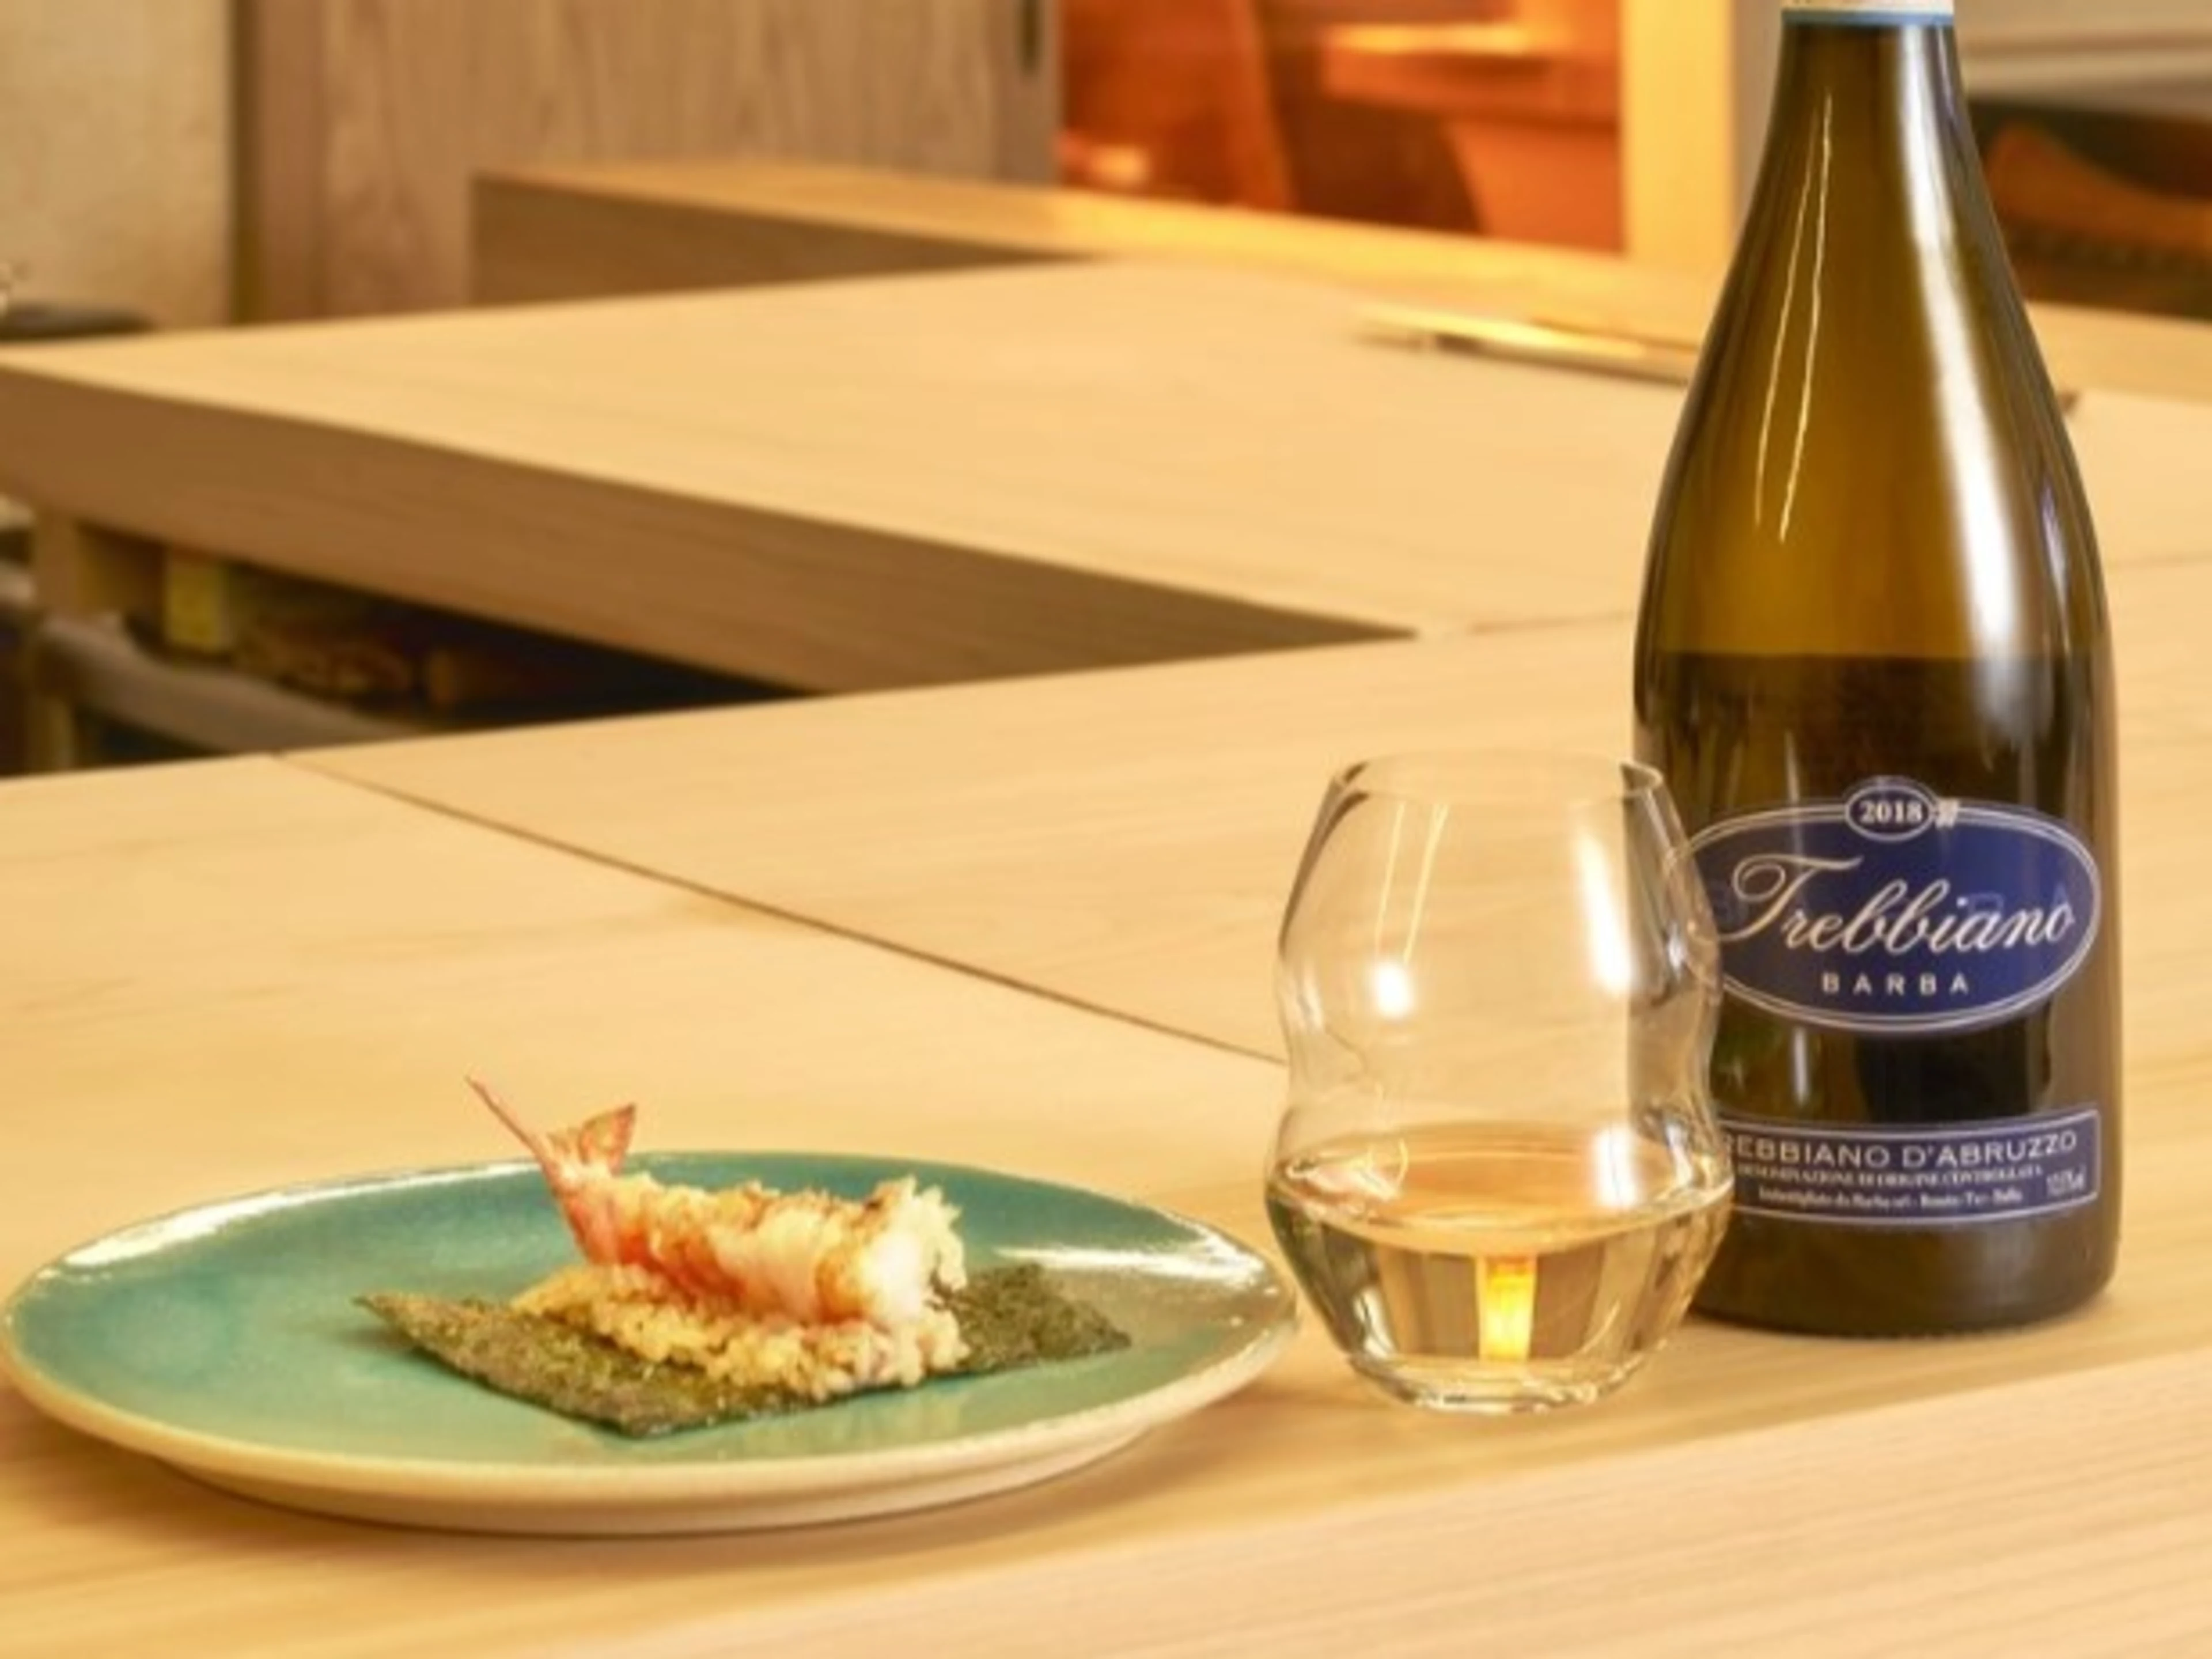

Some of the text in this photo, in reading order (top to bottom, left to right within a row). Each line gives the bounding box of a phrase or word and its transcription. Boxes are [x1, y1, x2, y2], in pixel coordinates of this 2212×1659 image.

[1860, 799, 1922, 823] 2018
[1719, 853, 2075, 955] Trebbiano
[1821, 972, 1969, 995] BARBA
[1902, 1130, 2077, 1169] D'ABRUZZO
